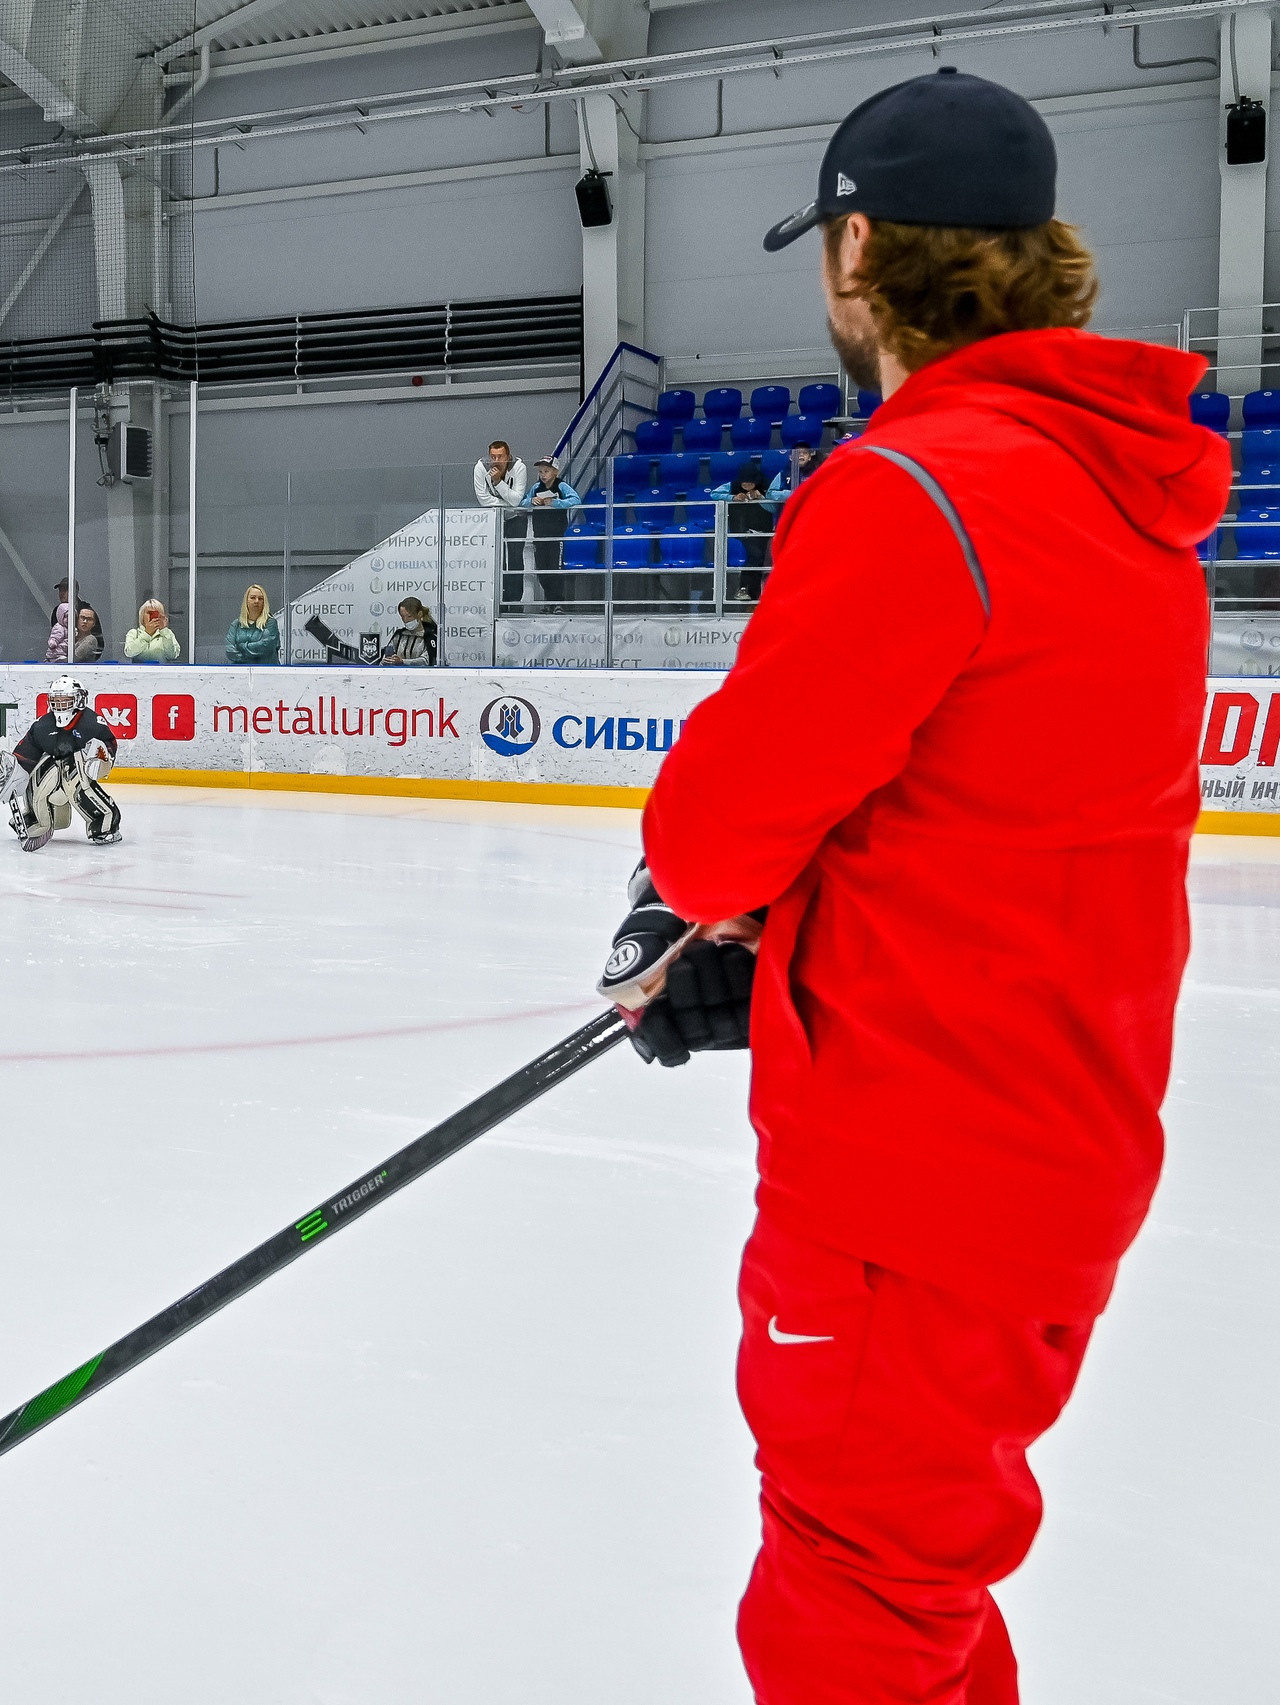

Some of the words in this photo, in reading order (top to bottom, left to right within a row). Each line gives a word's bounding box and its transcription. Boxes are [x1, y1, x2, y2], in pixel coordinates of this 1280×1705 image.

[212, 695, 460, 747] metallurgnk
[1201, 776, 1246, 799] НЫЙ
[1251, 781, 1280, 799] ИН
